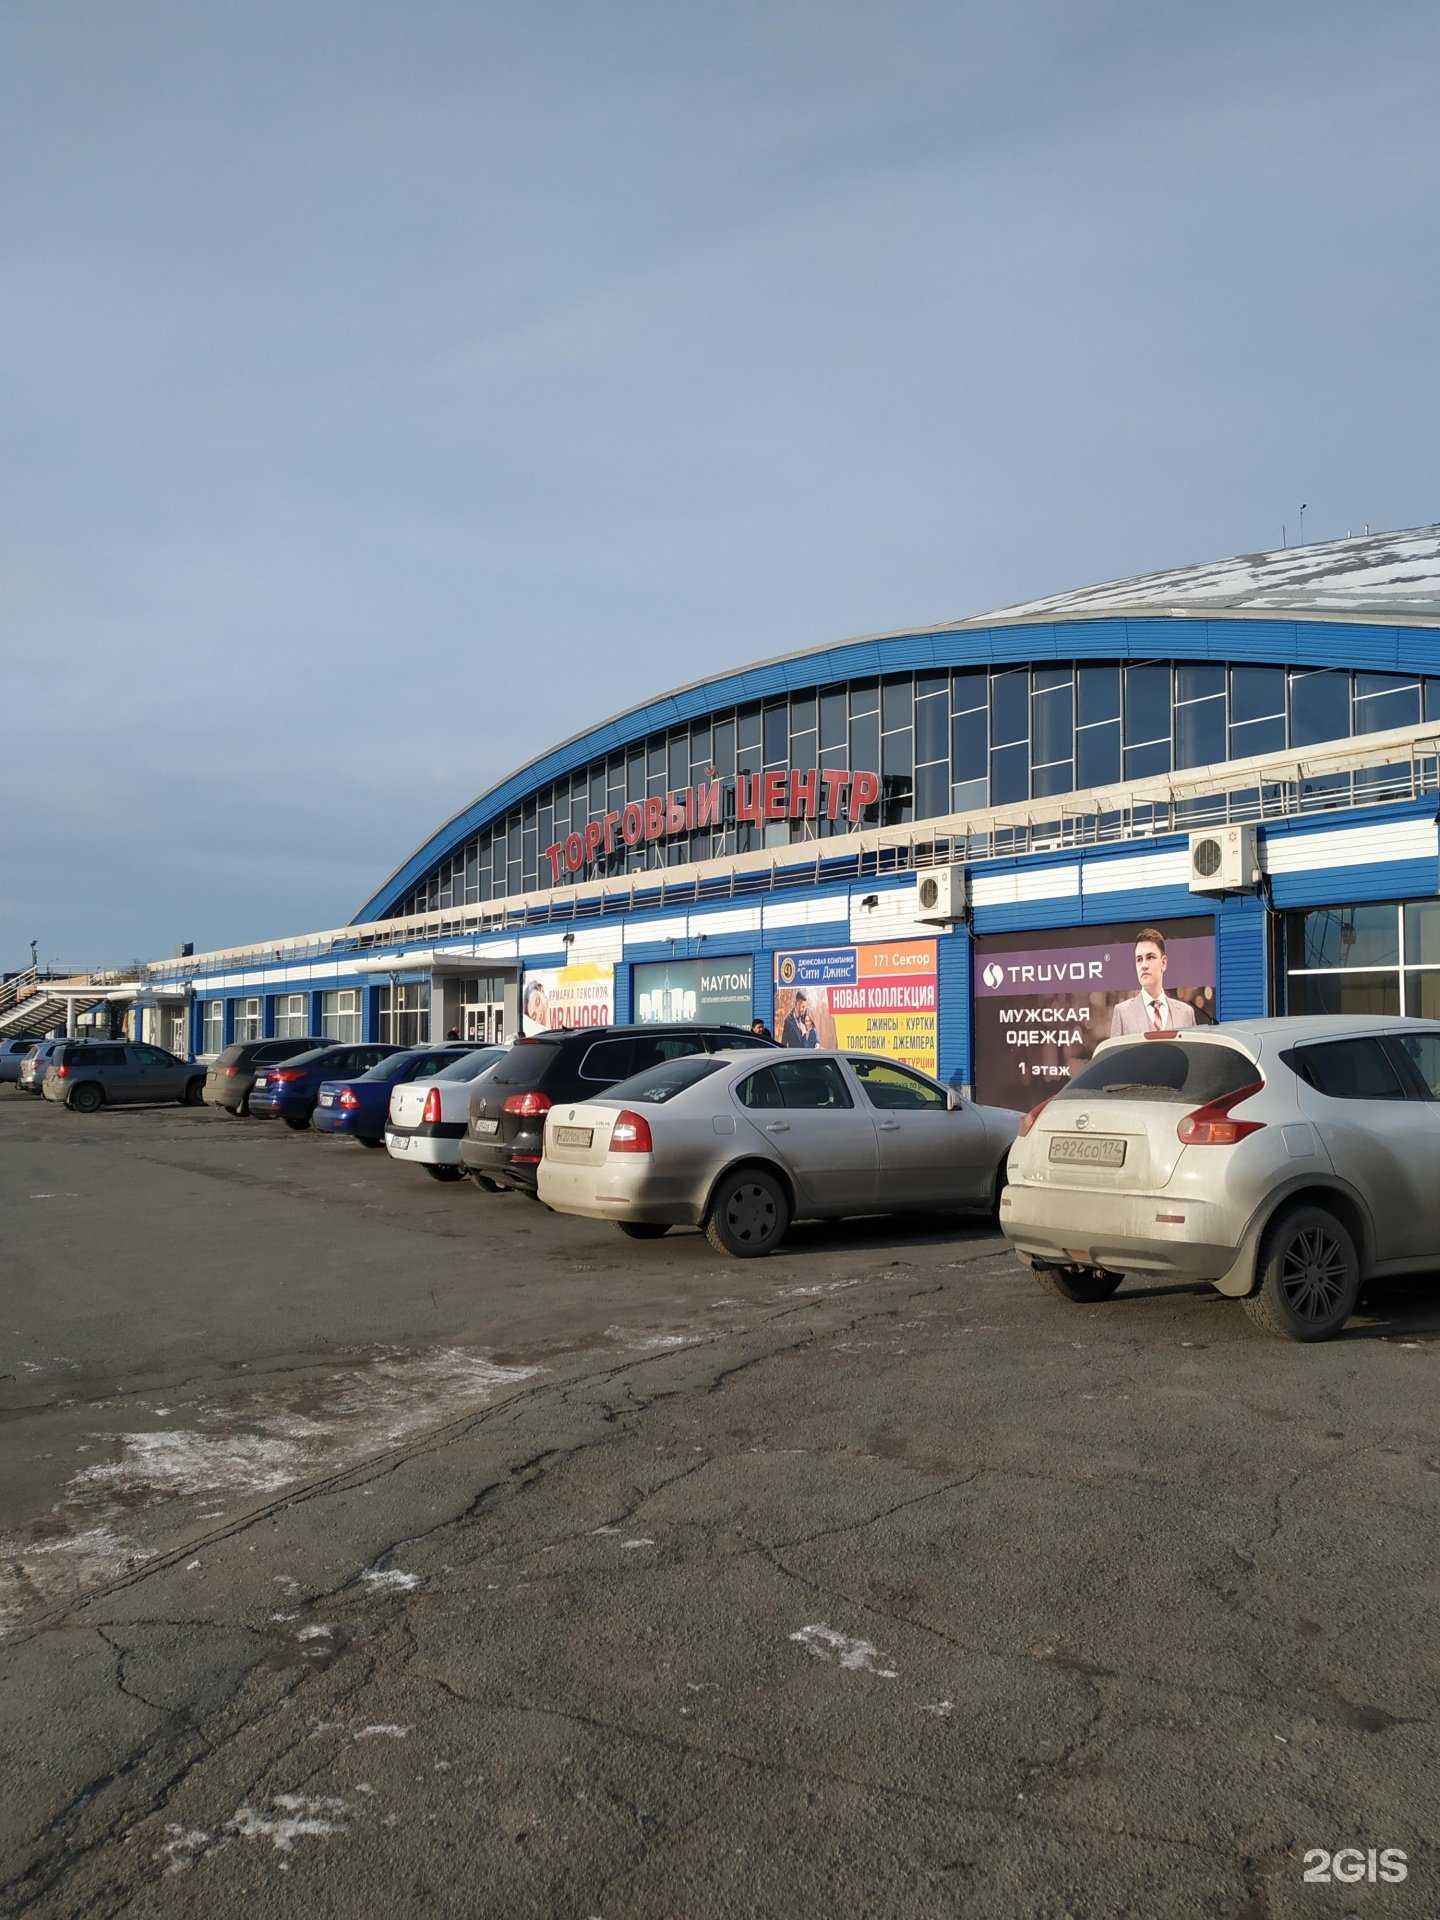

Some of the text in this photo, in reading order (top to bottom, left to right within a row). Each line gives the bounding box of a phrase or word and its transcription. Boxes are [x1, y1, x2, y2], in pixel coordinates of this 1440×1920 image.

[545, 766, 881, 883] ТОРГОВЫЙ ЦЕНТР
[891, 952, 930, 967] Сектор
[1008, 961, 1103, 983] TRUVOR
[833, 985, 935, 1009] НОВАЯ КОЛЛЕКЦИЯ
[999, 1007, 1090, 1024] МУЖСКАЯ
[866, 1017, 935, 1032] ДЖИНСЫ КУРТКИ
[846, 1035, 935, 1050] ТОЛСТОВКИ ДЖЕМПЕРА
[1006, 1030, 1083, 1047] ОДЕЖДА
[1018, 1062, 1071, 1076] 1 этаж
